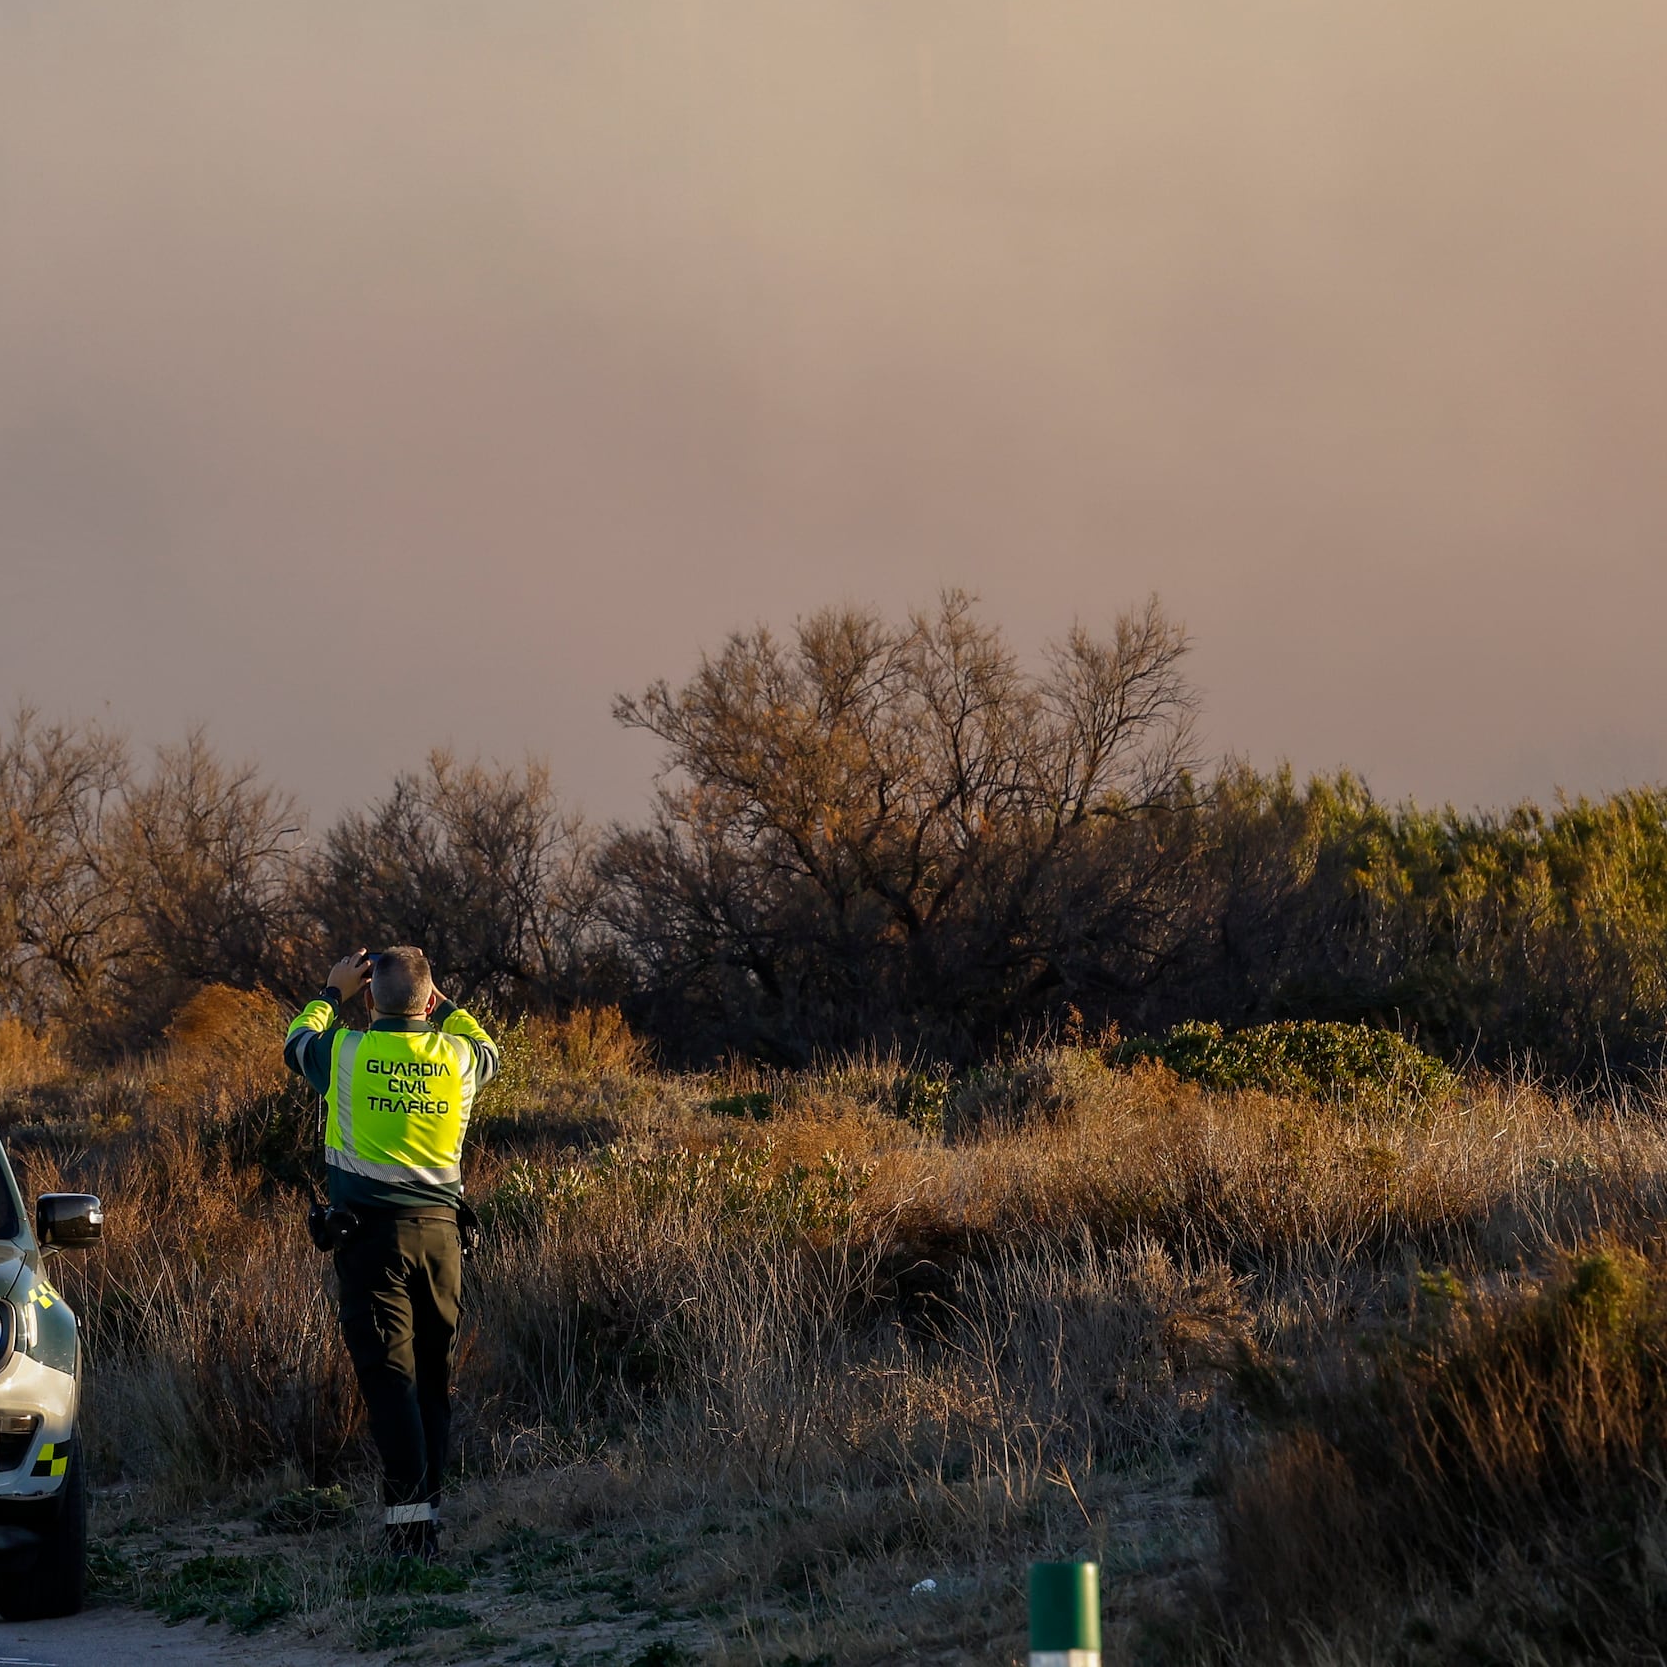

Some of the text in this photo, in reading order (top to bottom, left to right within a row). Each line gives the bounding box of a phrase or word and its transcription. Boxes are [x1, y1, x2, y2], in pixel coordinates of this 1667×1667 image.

[367, 1059, 450, 1076] GUARDIA
[387, 1078, 431, 1095] CIVIL
[367, 1095, 449, 1114] TRÁFICO
